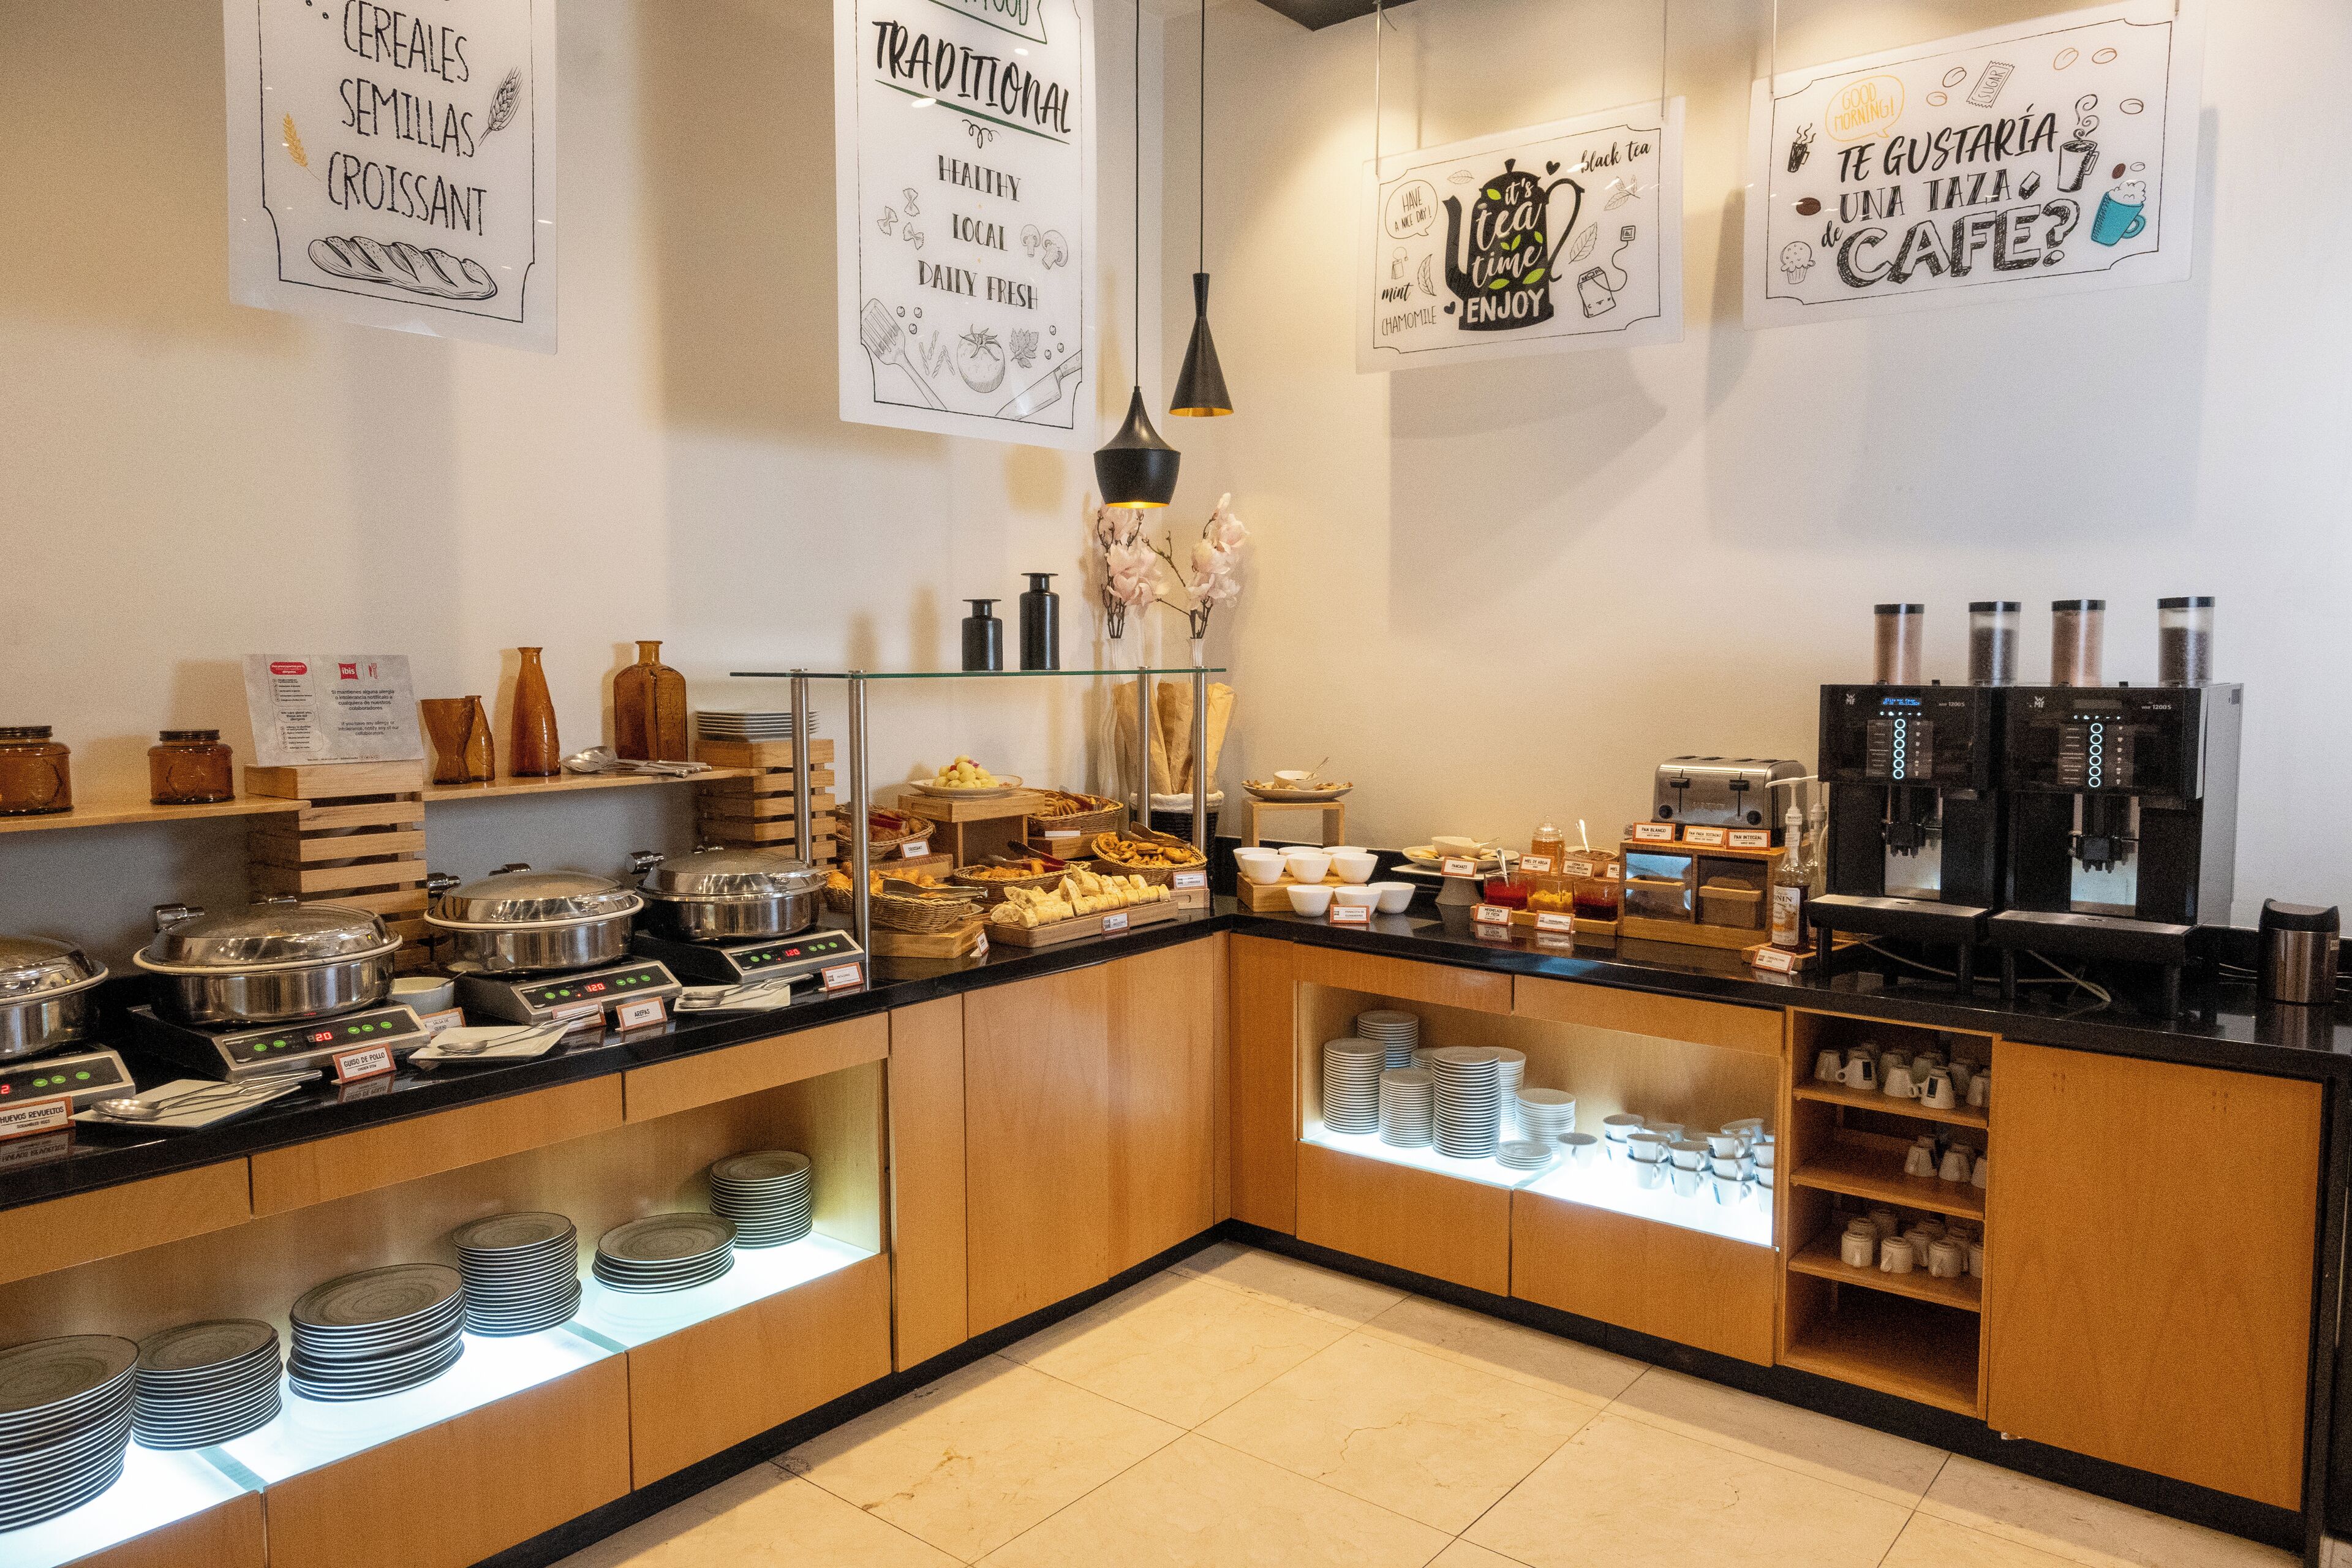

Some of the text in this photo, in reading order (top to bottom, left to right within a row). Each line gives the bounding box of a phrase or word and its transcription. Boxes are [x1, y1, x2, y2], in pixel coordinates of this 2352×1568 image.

[344, 0, 469, 83] CEREALES
[872, 20, 1071, 134] TRADITIONAL
[1978, 69, 2005, 100] SUGAR
[1842, 82, 1877, 110] GOOD
[340, 78, 475, 157] SEMILLAS
[1834, 94, 1894, 133] MORNING!
[1580, 141, 1652, 173] black tea
[1838, 103, 2060, 183] TE GUSTARÍA
[328, 151, 486, 236] CROISSANT
[938, 155, 1022, 202] HEALTHY
[1504, 177, 1534, 206] it's
[1401, 186, 1423, 213] HAVE
[1839, 169, 2013, 225] UNA TAZA
[952, 213, 1008, 252] LOCAL
[1395, 221, 1400, 232] A
[1401, 213, 1414, 229] NICE
[1476, 200, 1544, 252] tea
[1821, 221, 1845, 248] de
[1471, 245, 1543, 289] time
[918, 260, 1039, 311] DAILY FRESH
[1381, 282, 1414, 303] mint
[1382, 306, 1437, 336] CHAMOMILE
[1467, 288, 1545, 324] ENJOY
[785, 948, 801, 957] 120
[586, 982, 606, 993] 120
[634, 1008, 650, 1018] AREPAS
[315, 1031, 333, 1042] 20
[344, 1058, 360, 1068] GUISO
[369, 1052, 385, 1061] POLLO
[0, 1106, 64, 1124] HUEVOS REVUELTOS
